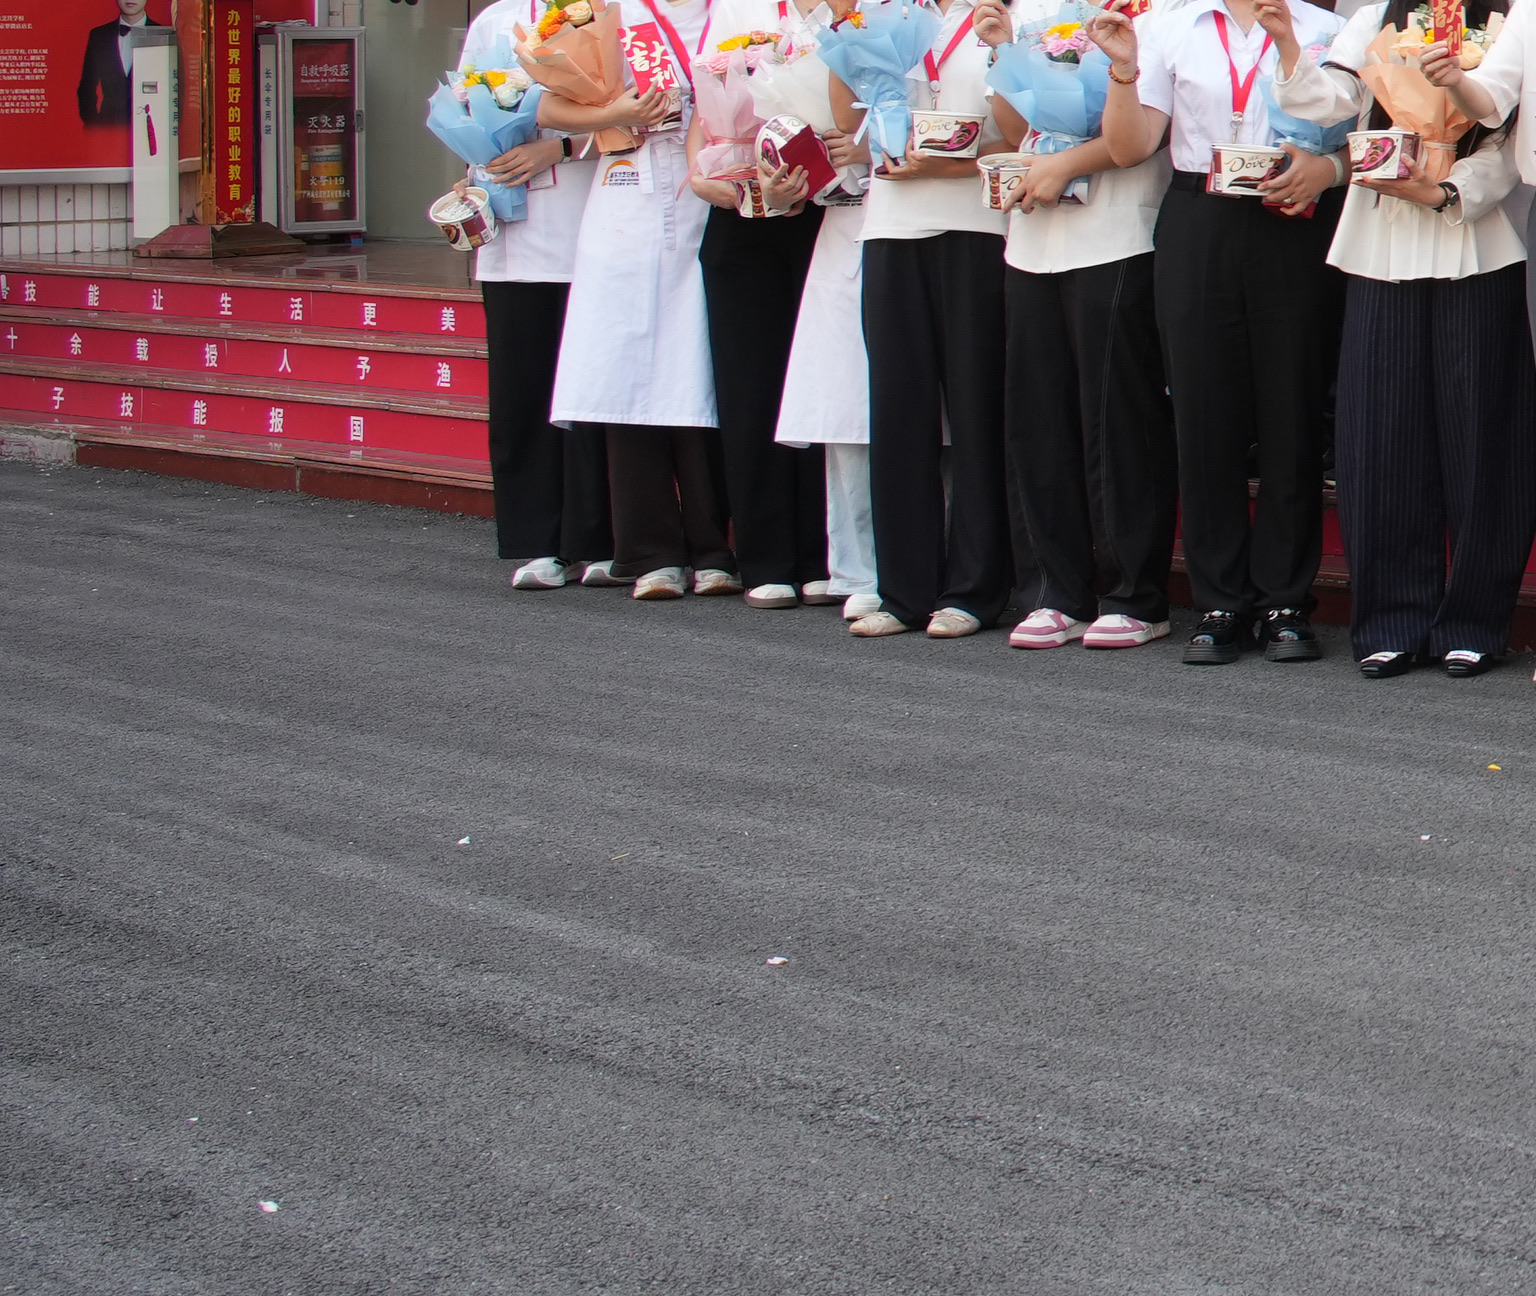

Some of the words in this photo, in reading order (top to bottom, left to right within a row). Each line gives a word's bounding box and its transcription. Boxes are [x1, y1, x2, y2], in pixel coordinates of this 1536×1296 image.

[300, 64, 349, 77] 自救呼吸器
[227, 9, 242, 201] 办世界最好的职业教育
[308, 115, 346, 128] 灭火器
[915, 117, 953, 134] Dove
[1228, 158, 1269, 173] Dove
[0, 275, 457, 332] 技能让生活更美
[7, 326, 452, 388] 十余载授人予渔
[52, 386, 365, 442] 子技能报国
